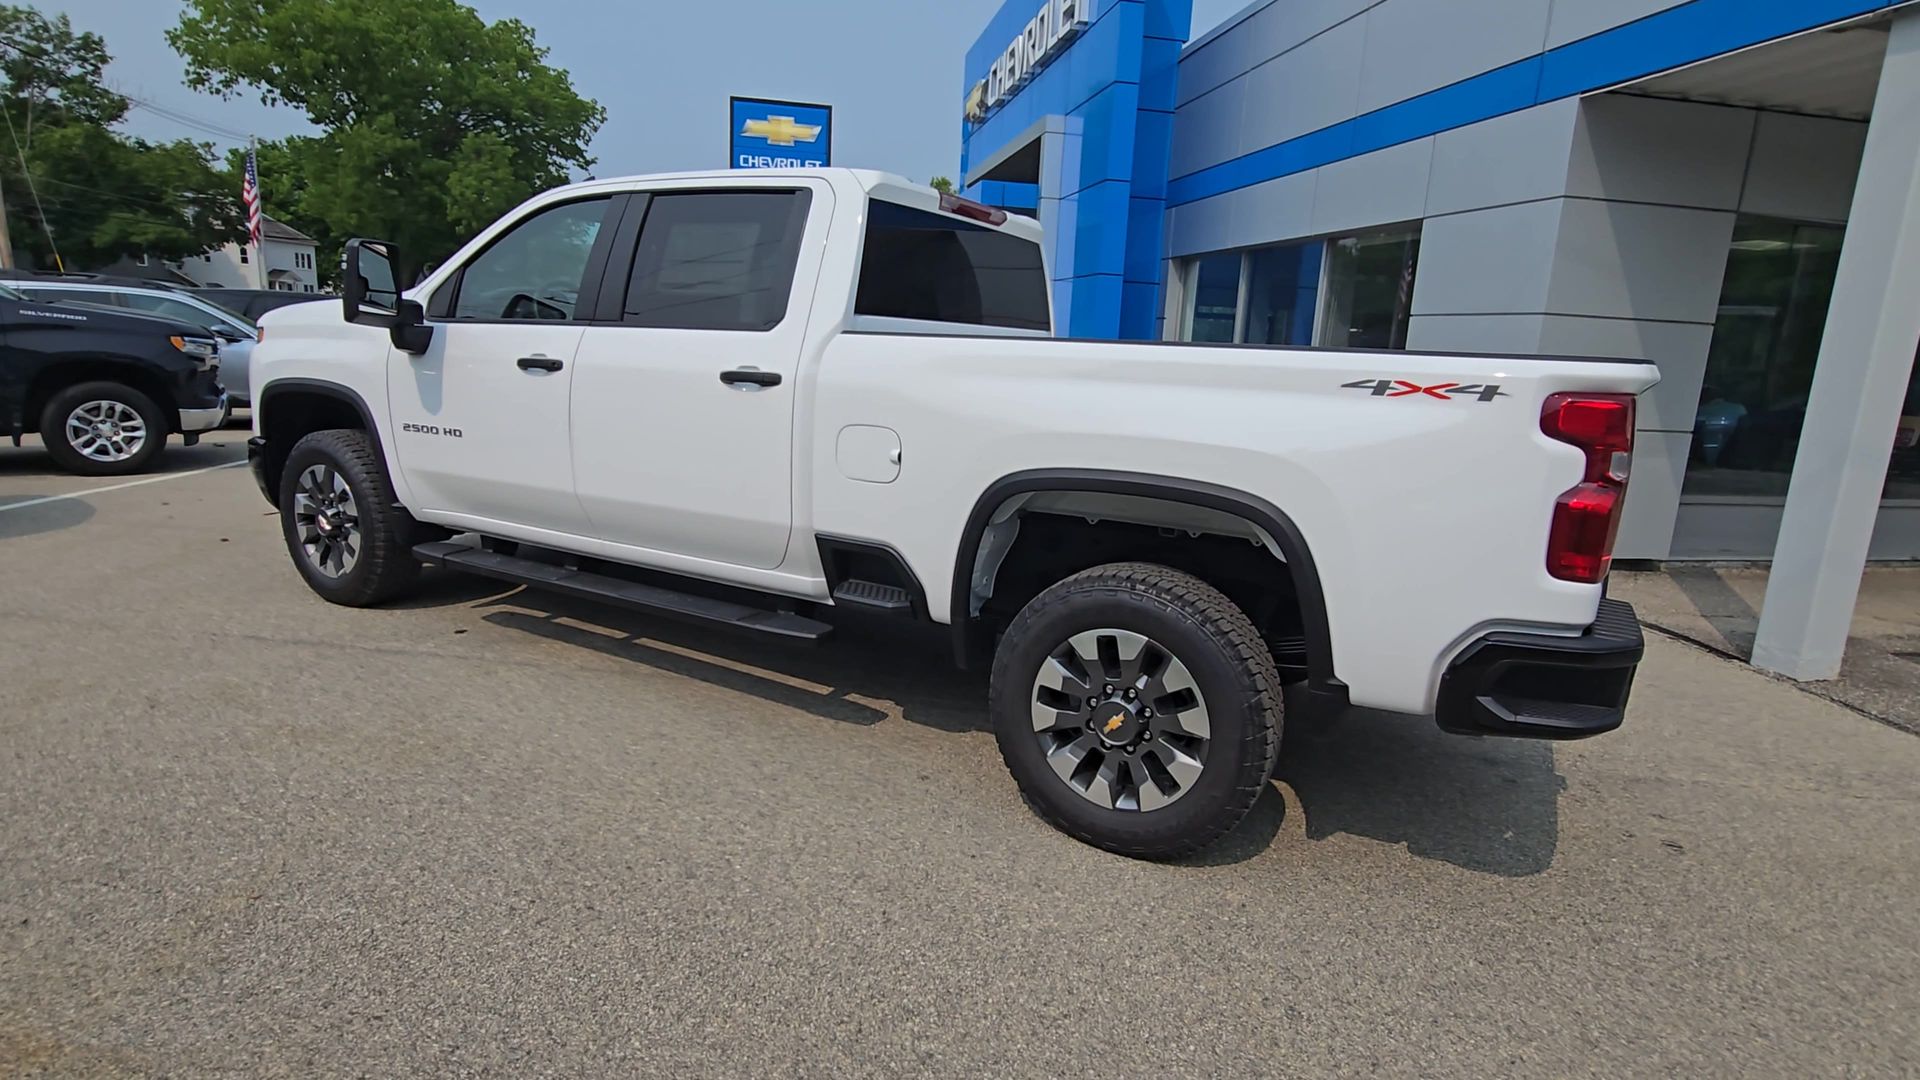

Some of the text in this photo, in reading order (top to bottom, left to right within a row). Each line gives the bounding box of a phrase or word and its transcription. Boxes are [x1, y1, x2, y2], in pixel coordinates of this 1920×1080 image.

[19, 309, 87, 321] SILVERADO
[402, 422, 463, 438] 2500 HD
